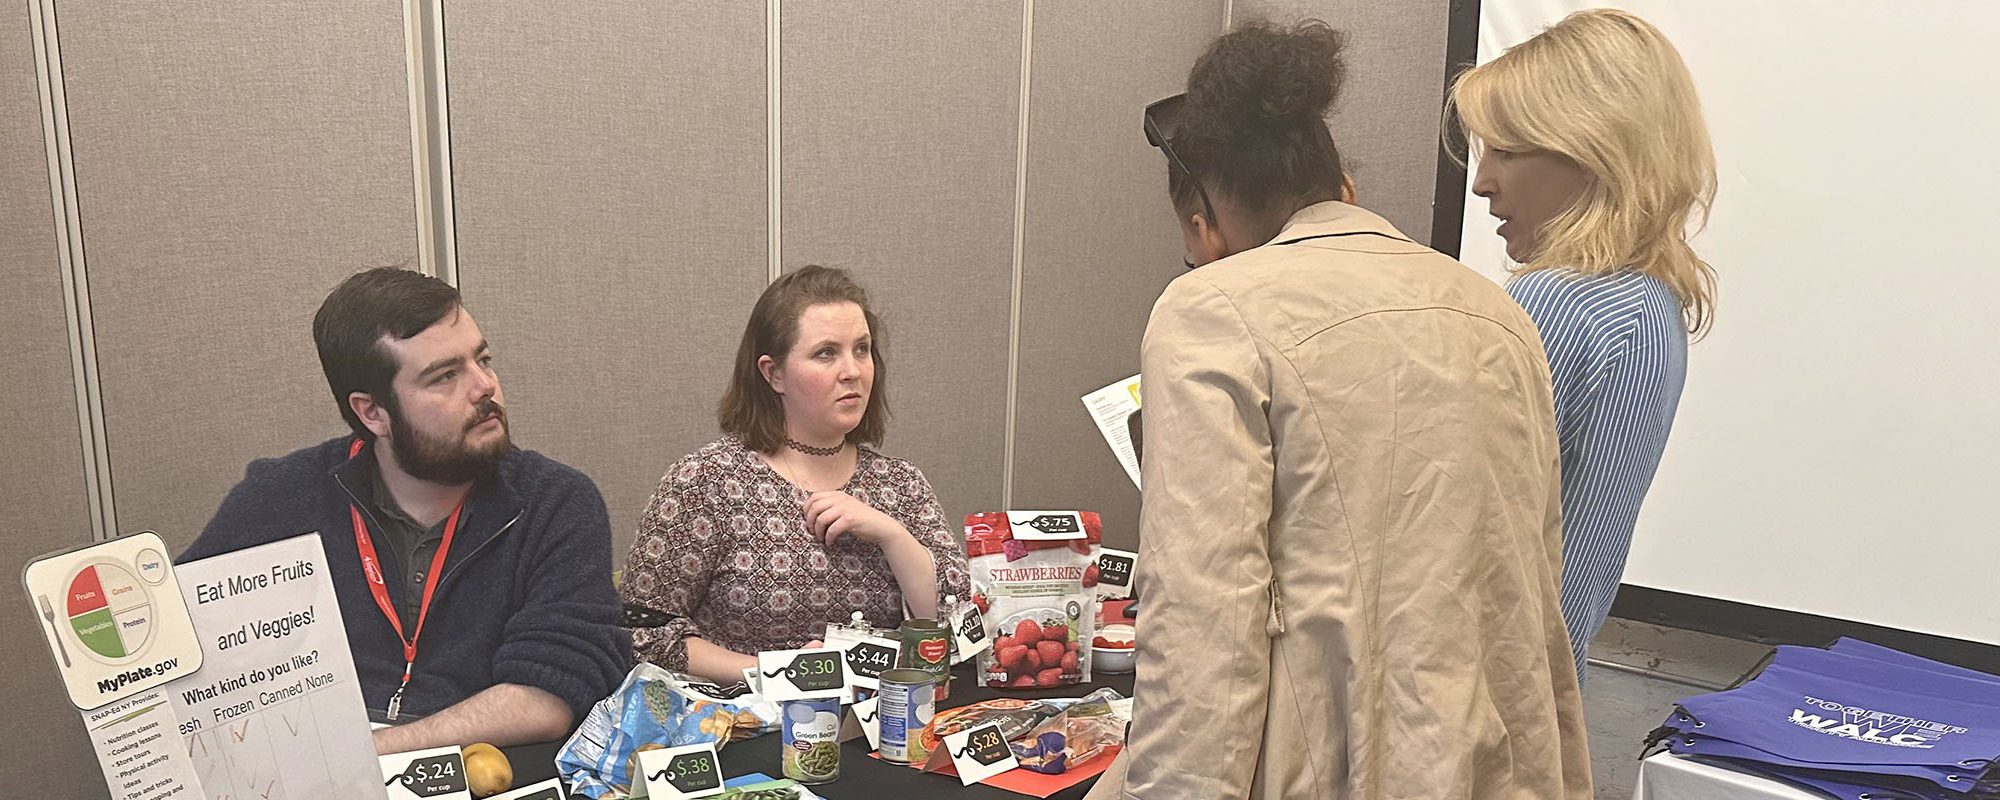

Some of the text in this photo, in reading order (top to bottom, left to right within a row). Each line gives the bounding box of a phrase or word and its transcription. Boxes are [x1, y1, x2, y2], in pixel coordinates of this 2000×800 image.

[1040, 517, 1071, 527] $.75
[142, 562, 159, 571] Dairy
[990, 567, 1082, 582] STRAWBERRIES
[1100, 559, 1127, 573] $1.81
[112, 585, 133, 596] Grains
[196, 560, 314, 605] Eat More Fruits
[75, 591, 96, 601] Fruits
[78, 621, 113, 636] Vegetables
[122, 617, 146, 629] Protein
[218, 605, 316, 651] and Veggies!
[857, 647, 889, 667] $.44
[97, 658, 178, 694] MyPlate.gov
[182, 650, 319, 706] What kind do you like?
[799, 659, 835, 677] $.30
[91, 691, 160, 722] SNAP-Ed NY Provides:
[179, 671, 335, 735] esh Frozen Canned None
[1804, 695, 1968, 735] TOGETHER
[107, 721, 158, 745] Nutrition classes
[795, 731, 818, 739] Green
[973, 731, 999, 752] $.28
[111, 732, 161, 756] Cooking lessons
[115, 750, 151, 767] Store tours
[120, 754, 169, 778] Physical activity
[677, 757, 710, 778] $.38
[415, 761, 456, 783] $.24
[127, 778, 173, 800] Tips and tricks
[172, 784, 184, 793] and
